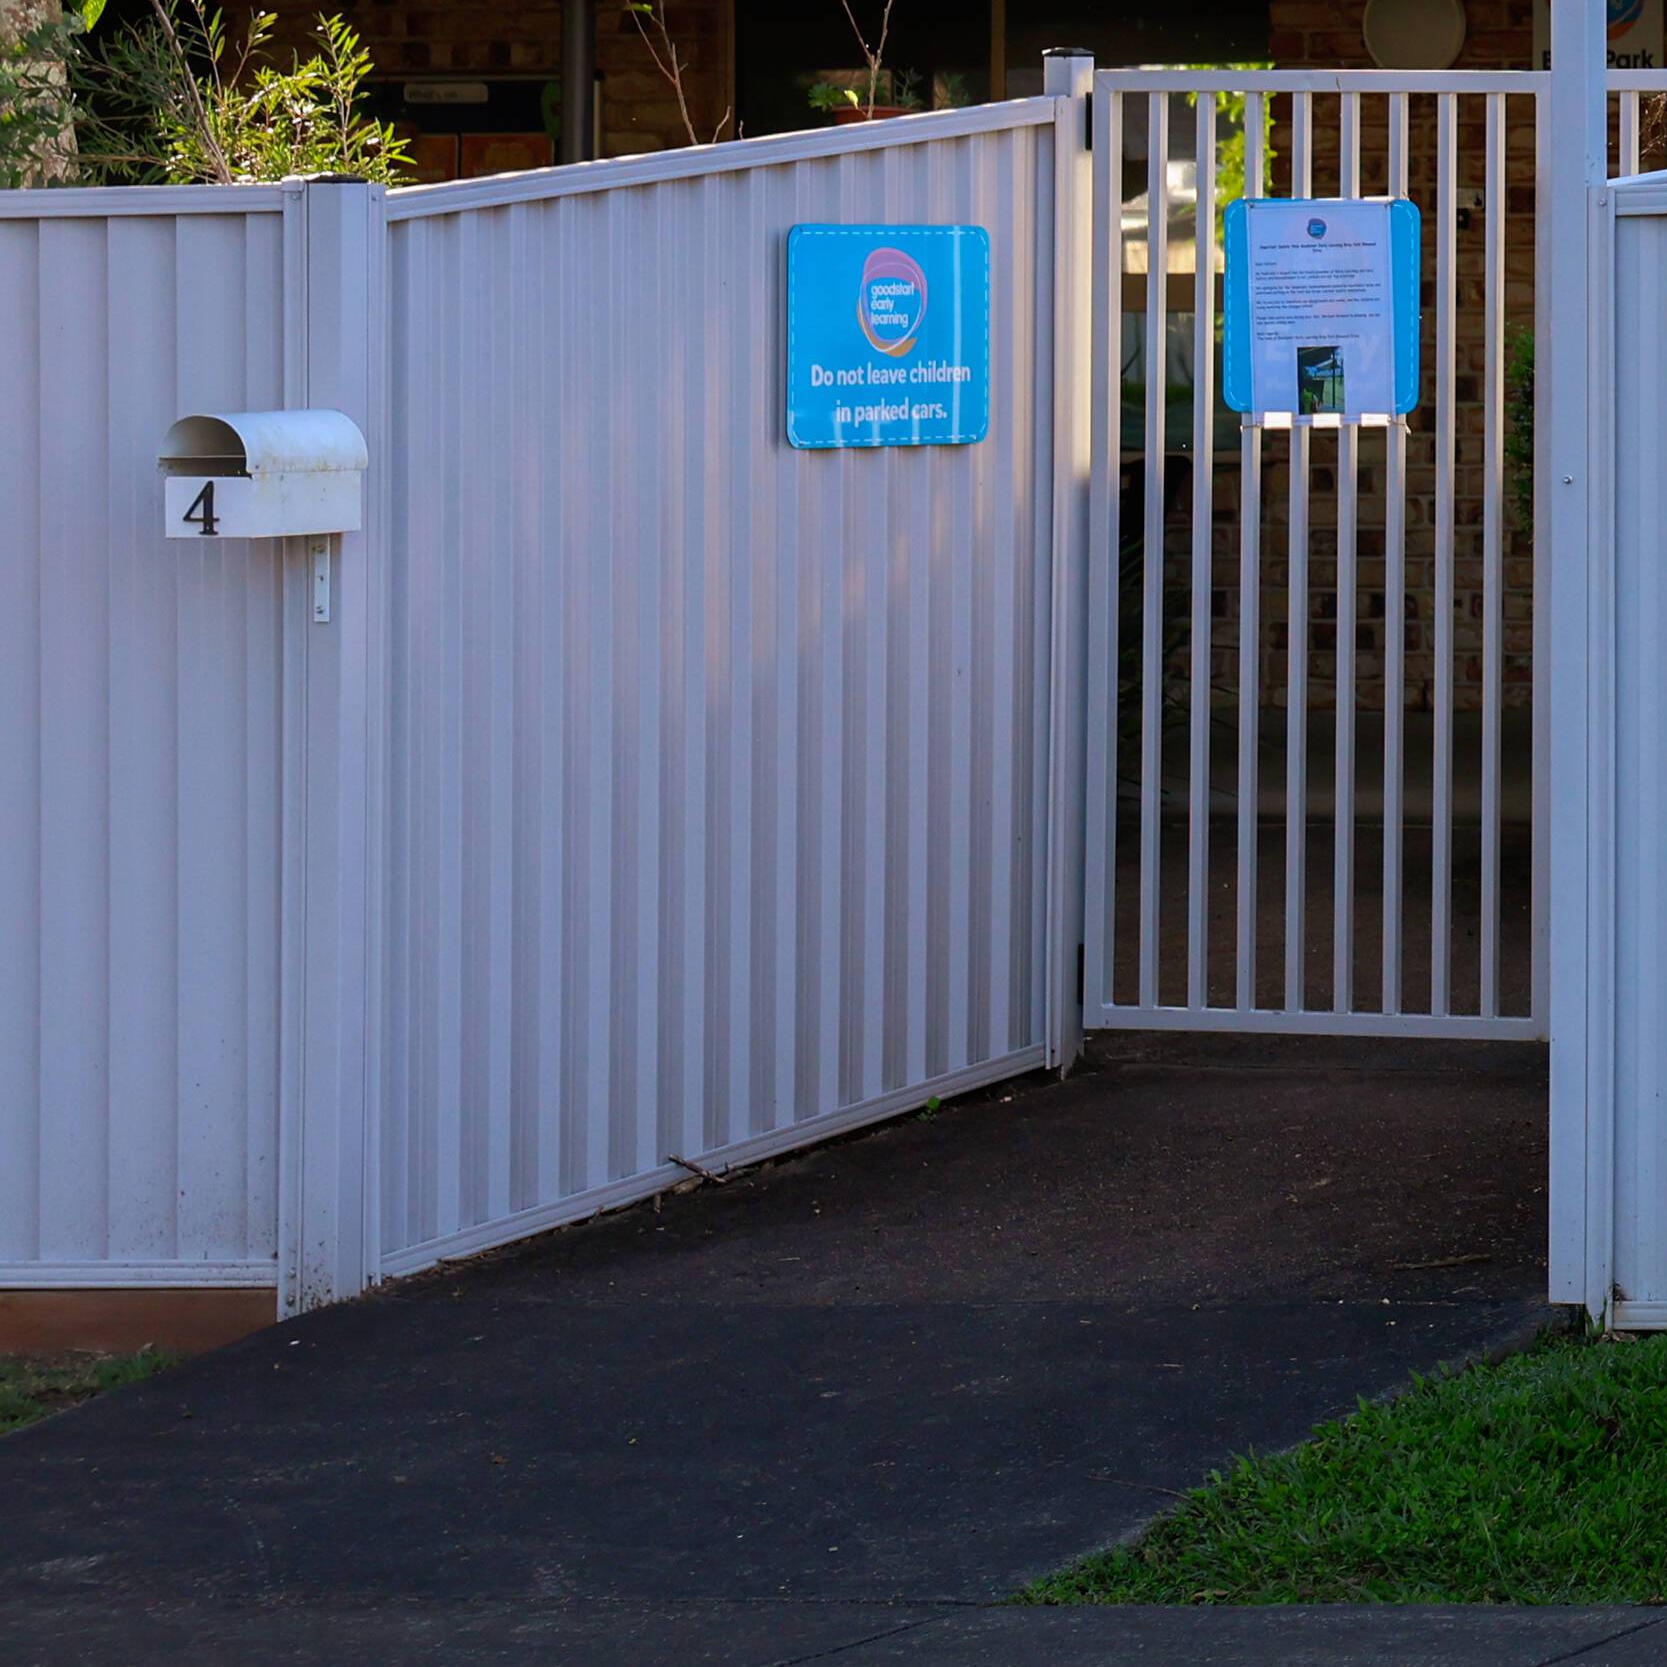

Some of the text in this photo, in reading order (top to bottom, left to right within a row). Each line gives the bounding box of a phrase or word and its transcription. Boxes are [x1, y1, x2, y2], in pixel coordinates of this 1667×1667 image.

[870, 282, 914, 300] goodstart
[871, 297, 895, 313] early
[871, 311, 909, 328] learning
[811, 360, 971, 387] Do not leave children
[836, 397, 948, 428] in parked cars.
[183, 480, 220, 535] 4
